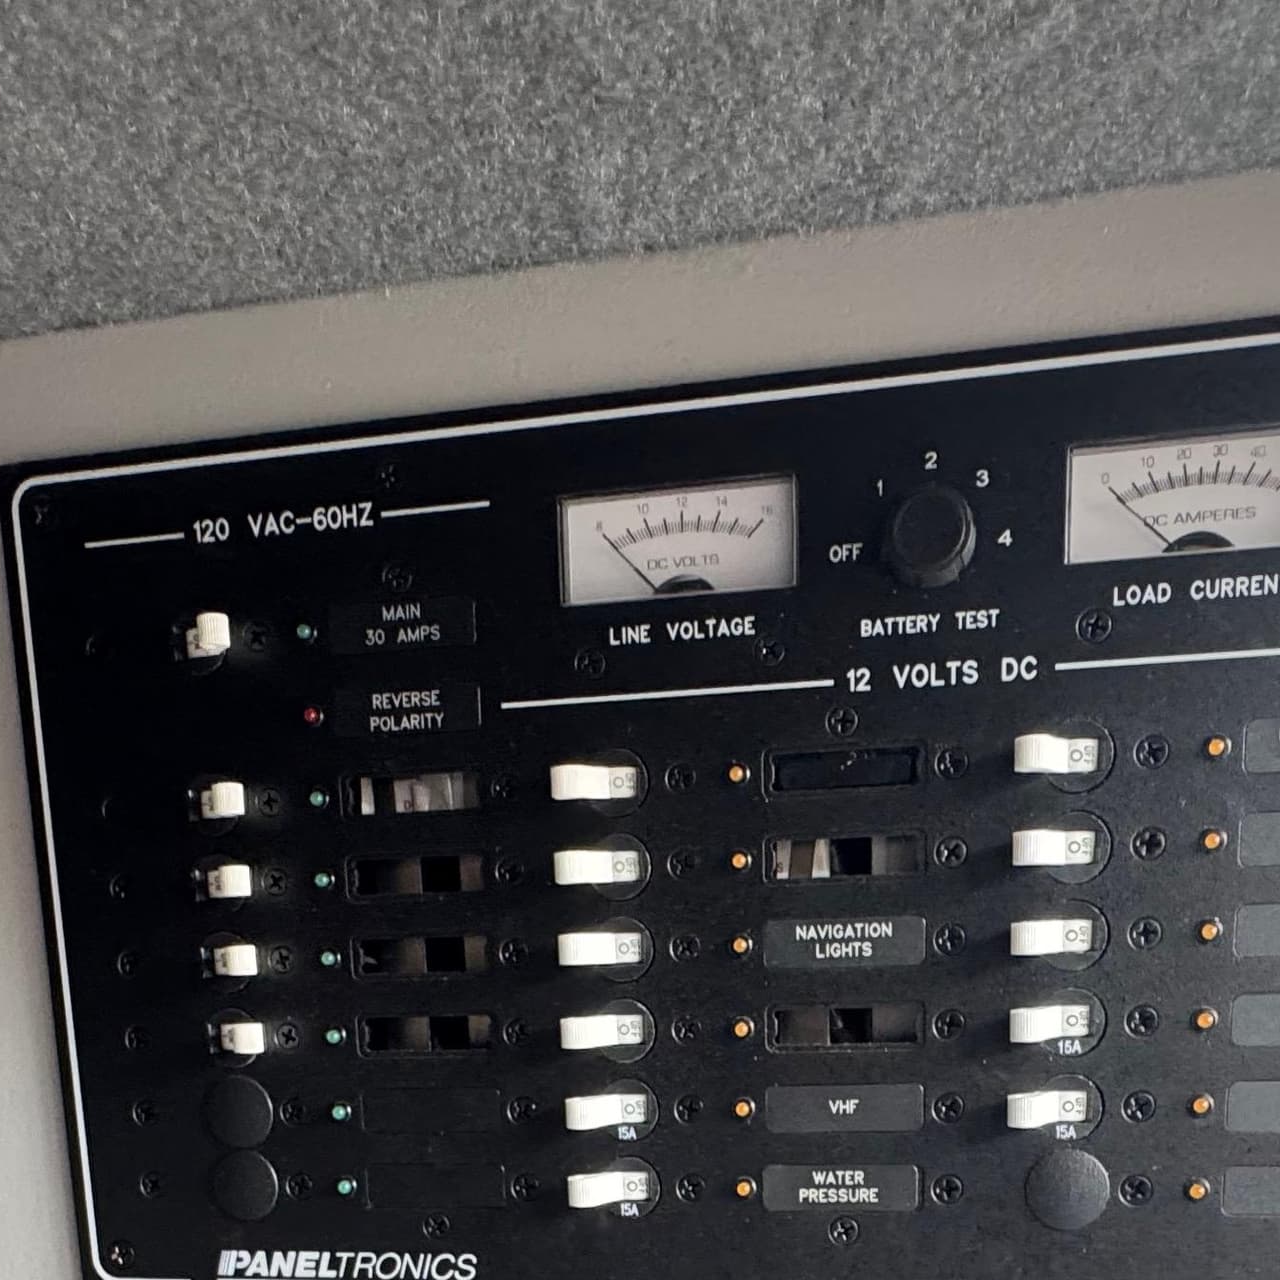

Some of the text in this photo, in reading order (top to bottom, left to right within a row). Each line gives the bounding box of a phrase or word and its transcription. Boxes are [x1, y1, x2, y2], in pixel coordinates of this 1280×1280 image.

[1177, 447, 1192, 460] 20
[1213, 444, 1228, 457] 30
[1250, 445, 1267, 457] 40
[924, 451, 938, 470] 2
[1141, 455, 1154, 468] 10
[876, 479, 884, 497] 1
[976, 469, 989, 488] 3
[637, 503, 649, 515] 10
[676, 496, 688, 507] 12
[717, 495, 728, 507] 14
[193, 502, 374, 544] 120 VAC-60HZ
[1144, 506, 1256, 527] DC AMPERES
[997, 528, 1013, 547] 4
[829, 543, 863, 564] OFF
[647, 557, 669, 570] DC
[1112, 582, 1172, 607] LOAD
[382, 604, 421, 623] MAIN
[860, 608, 1001, 638] BATTERY TEST
[364, 625, 441, 646] 30 AMPS
[609, 615, 756, 647] LINE VOLTAGE
[846, 656, 1038, 693] 12 VOLTS DC
[372, 689, 440, 710] REVERSE
[370, 711, 445, 732] POLARITY
[796, 921, 893, 942] NAVIGATION
[815, 939, 872, 960] LIGHTS
[1057, 1039, 1082, 1055] 15A
[828, 1099, 860, 1116] VHF
[618, 1126, 637, 1141] 15A
[1055, 1124, 1077, 1140] 15A
[812, 1169, 865, 1186] WATER
[799, 1185, 879, 1204] PRESSURE
[620, 1202, 639, 1217] 15A
